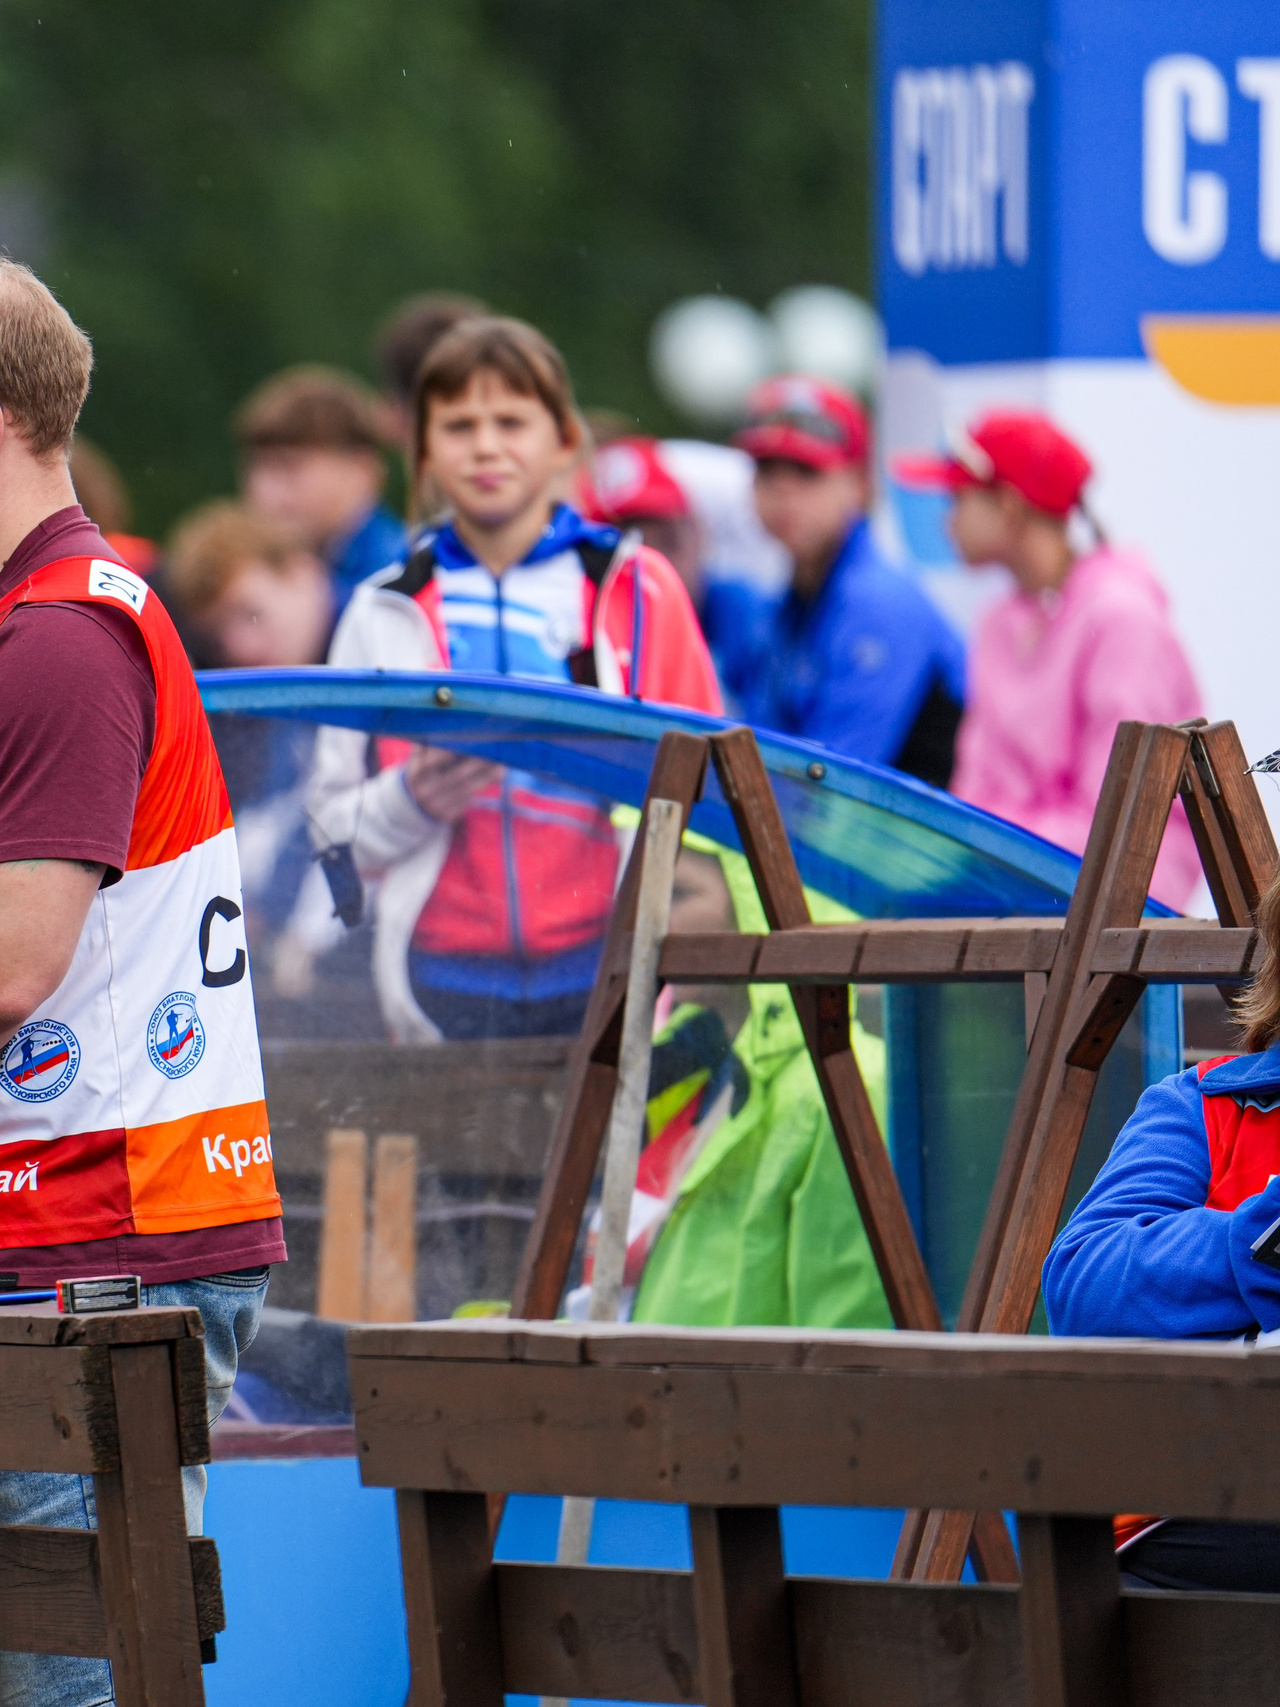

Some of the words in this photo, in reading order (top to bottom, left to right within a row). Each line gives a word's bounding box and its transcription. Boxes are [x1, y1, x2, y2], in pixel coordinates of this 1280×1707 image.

[149, 1007, 162, 1035] СОЮЗ
[0, 1035, 18, 1060] СОЮЗ
[192, 1034, 202, 1058] КРАЯ
[0, 1071, 67, 1100] КРАСНОЯРСКОГО
[64, 1057, 78, 1081] КРАЯ
[202, 1133, 273, 1177] Кра
